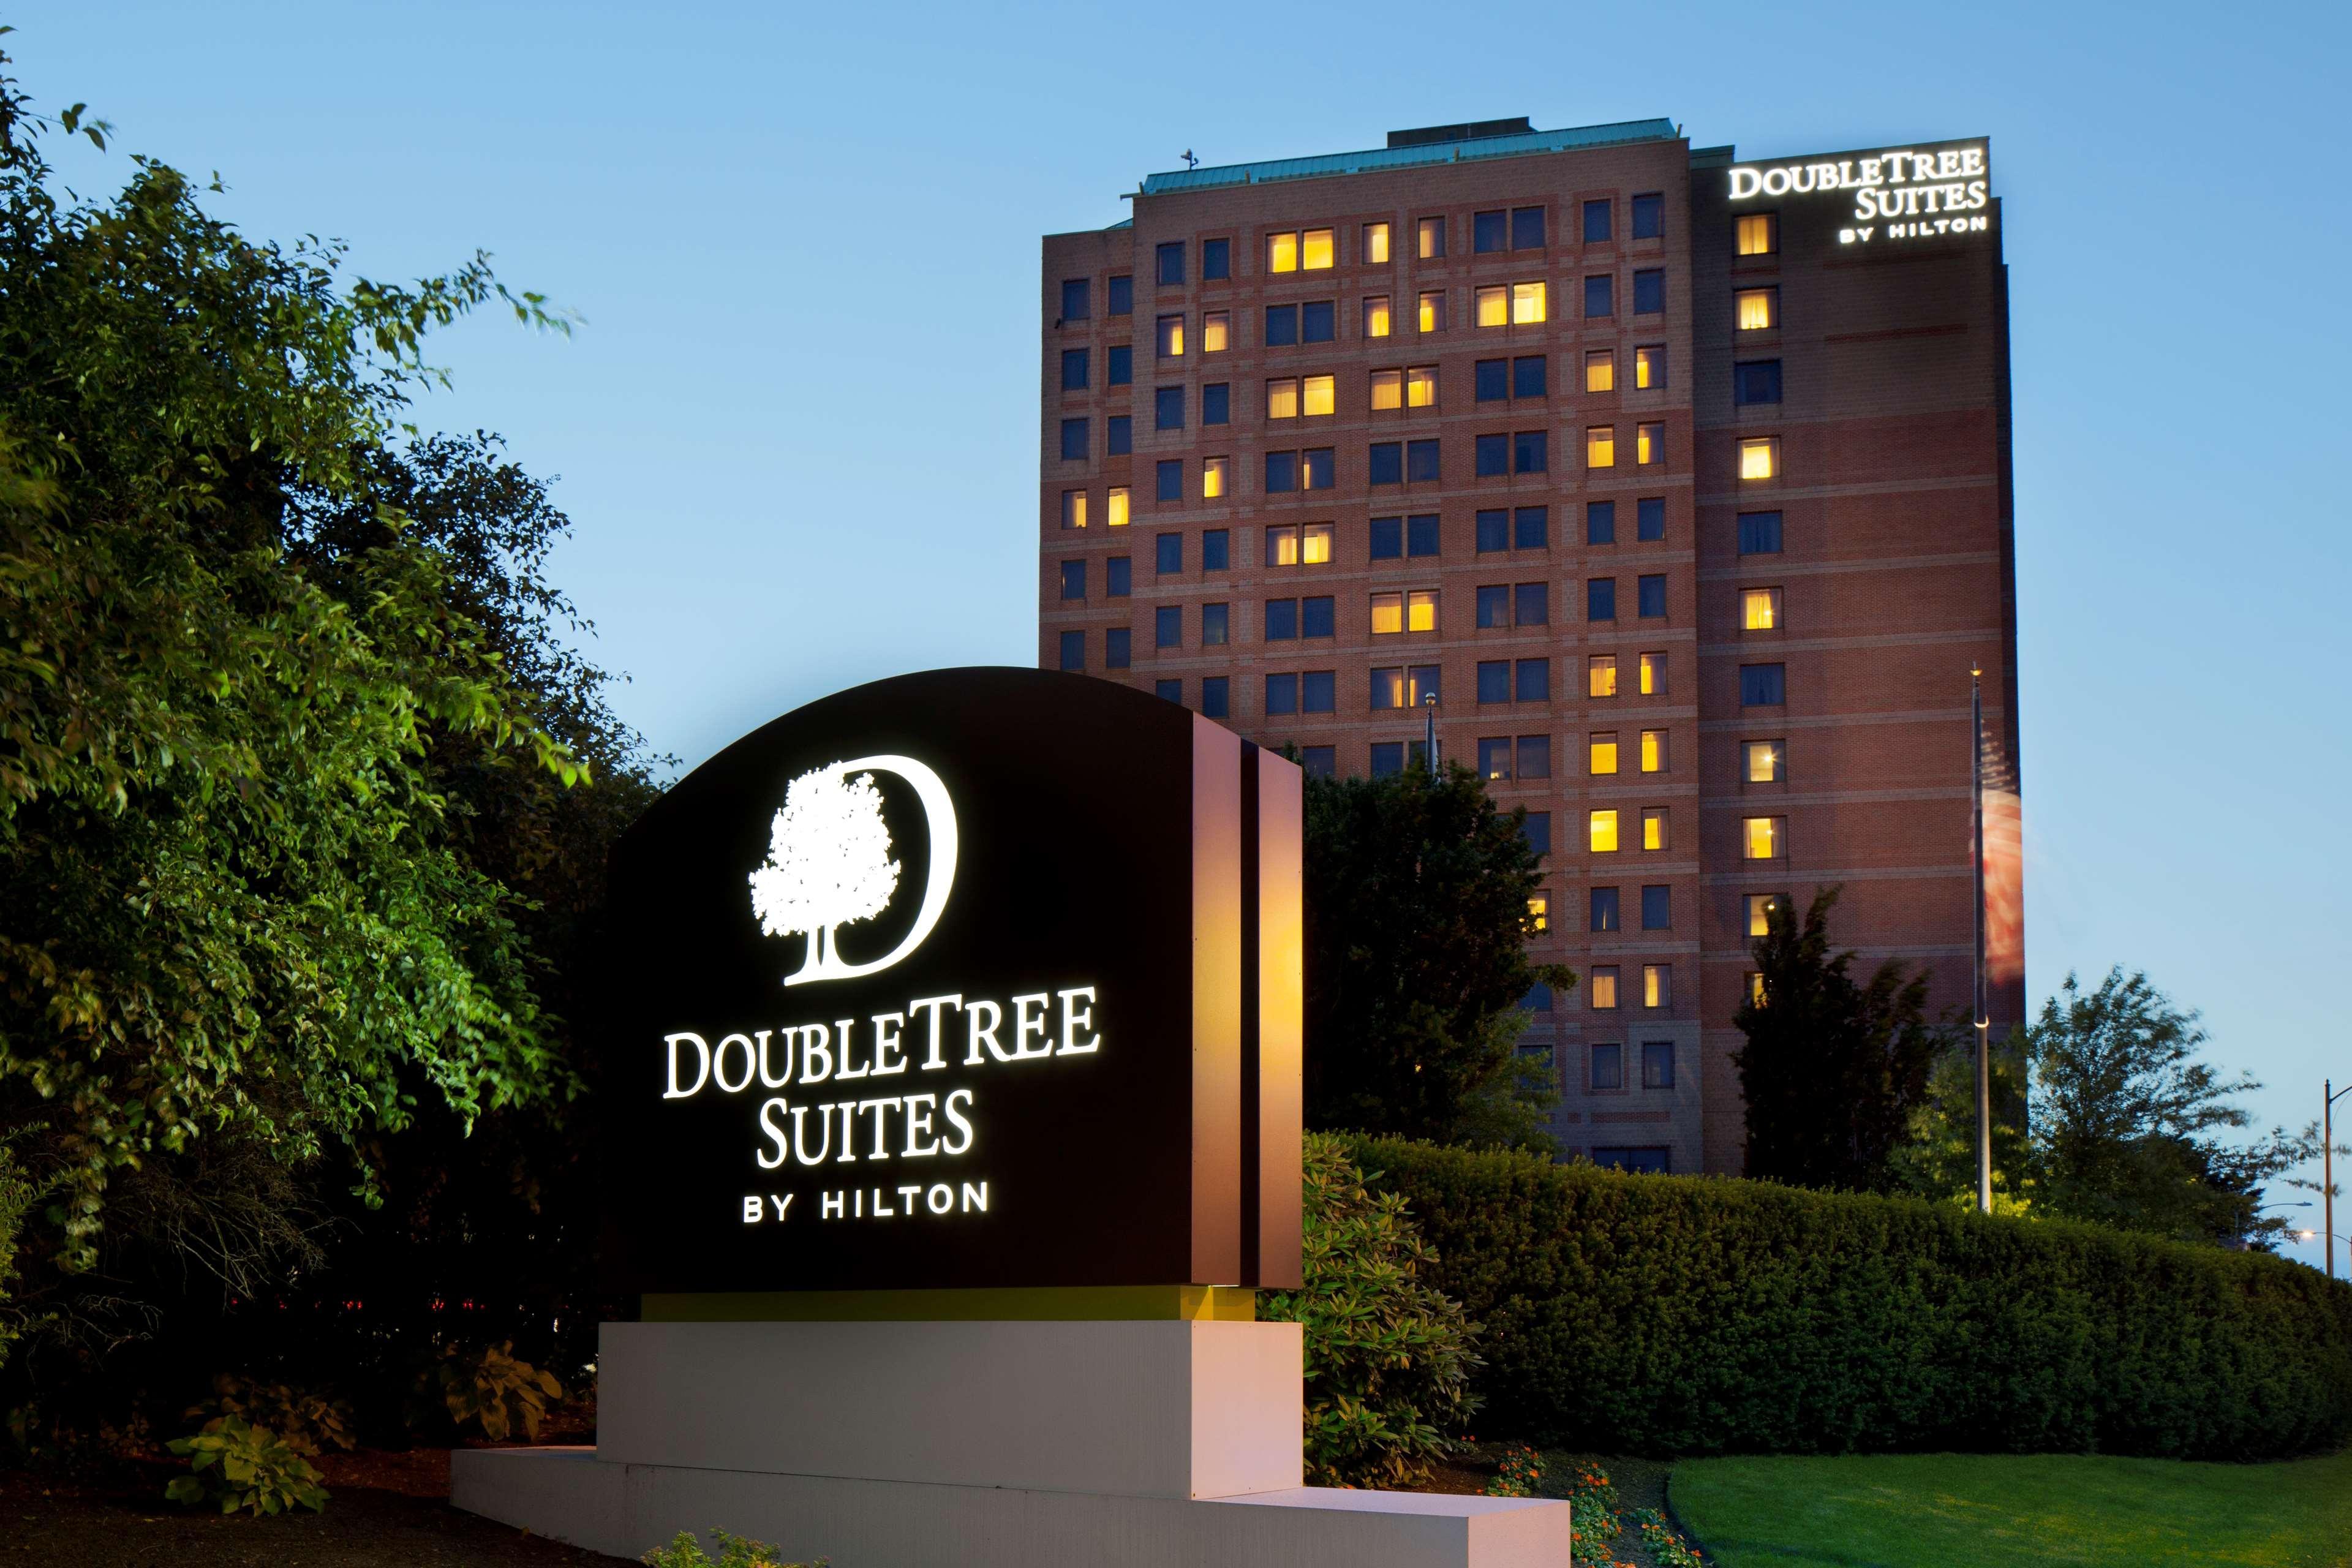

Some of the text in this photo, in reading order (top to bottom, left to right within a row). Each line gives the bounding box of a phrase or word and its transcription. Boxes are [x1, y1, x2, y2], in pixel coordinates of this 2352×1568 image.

[1855, 181, 1986, 220] SUITES
[1839, 216, 1987, 244] BY HILTON
[757, 1089, 973, 1169] SUITES
[744, 1182, 987, 1223] BY HILTON
